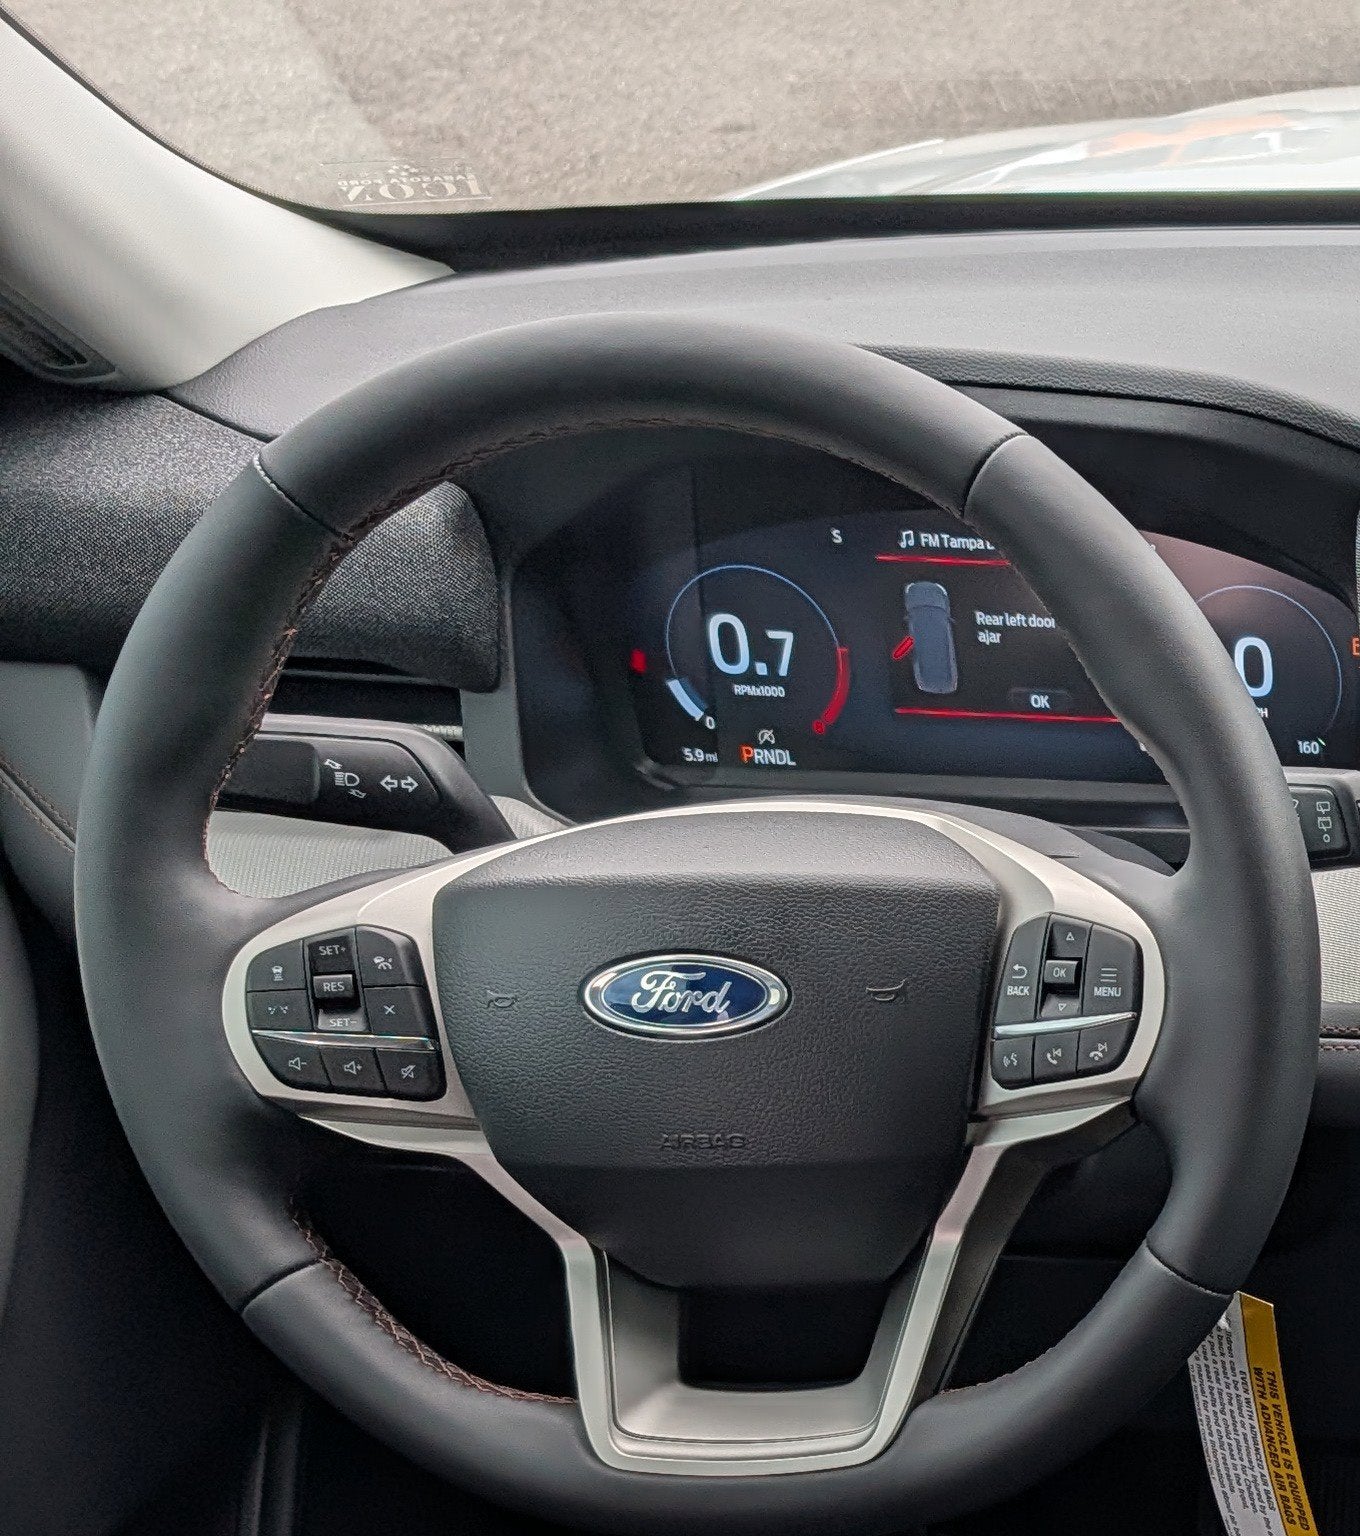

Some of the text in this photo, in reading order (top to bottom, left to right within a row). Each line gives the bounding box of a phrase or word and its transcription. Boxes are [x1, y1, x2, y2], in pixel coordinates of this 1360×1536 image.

[831, 528, 843, 543] S
[920, 533, 939, 548] FM
[942, 533, 984, 551] Tampa
[975, 611, 1004, 626] Rear
[1005, 612, 1027, 627] left
[708, 613, 794, 677] 0.7
[978, 631, 1002, 645] ajar
[1235, 636, 1273, 697] 0
[734, 684, 785, 698] RPMx1000
[1031, 695, 1050, 709] OK
[705, 716, 715, 730] 0
[1298, 740, 1319, 754] 160
[682, 747, 718, 762] 5.9 mi
[319, 945, 346, 956] SET+
[1053, 967, 1067, 978] OK
[323, 981, 345, 992] RES
[631, 970, 732, 1014] Ford
[1007, 986, 1030, 996] BACK
[1093, 986, 1121, 997] MENU
[1240, 1371, 1276, 1510] EVEN WITH ADVANCED AIR BAGS
[1254, 1366, 1297, 1525] WITH ADVANCED AIR BAGS
[1266, 1370, 1310, 1530] THIS VEHICLE IS EQUIPPED
